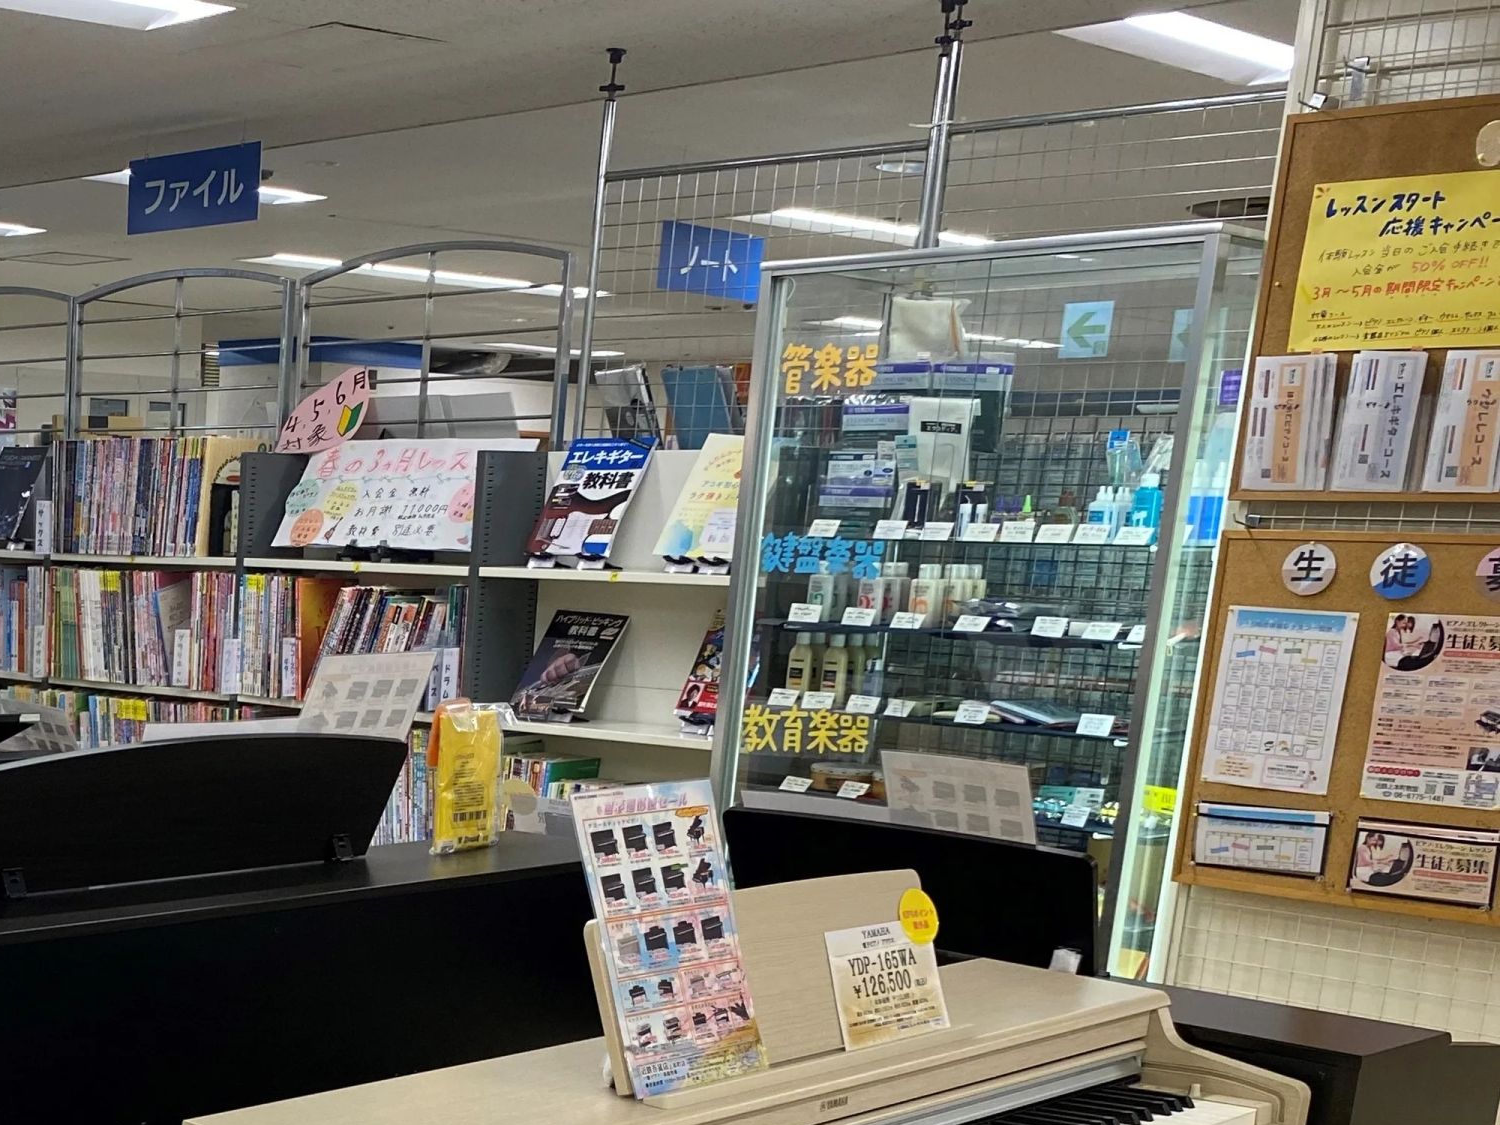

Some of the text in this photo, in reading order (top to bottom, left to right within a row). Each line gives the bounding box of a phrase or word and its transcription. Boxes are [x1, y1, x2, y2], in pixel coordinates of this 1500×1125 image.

[145, 168, 243, 215] ファイル
[1326, 190, 1446, 218] レッスンスタート
[680, 245, 738, 282] ノート
[1411, 258, 1445, 274] 50%
[1451, 256, 1489, 270] OFF!!
[781, 342, 879, 393] 管楽器
[281, 425, 334, 450] 対象
[1380, 383, 1405, 478] エレキギターコース
[569, 450, 644, 465] エレキギター
[363, 487, 398, 499] 入会金
[583, 471, 635, 490] 教科書
[402, 504, 449, 515] 11000円
[761, 531, 885, 580] 鍵盤楽器
[1291, 550, 1418, 589] 生 徒
[431, 665, 439, 697] ベース
[742, 704, 871, 754] 教育楽器
[861, 927, 891, 939] YAMAHA
[848, 948, 917, 977] YDP-165WA
[853, 969, 912, 999] ¥126,500
